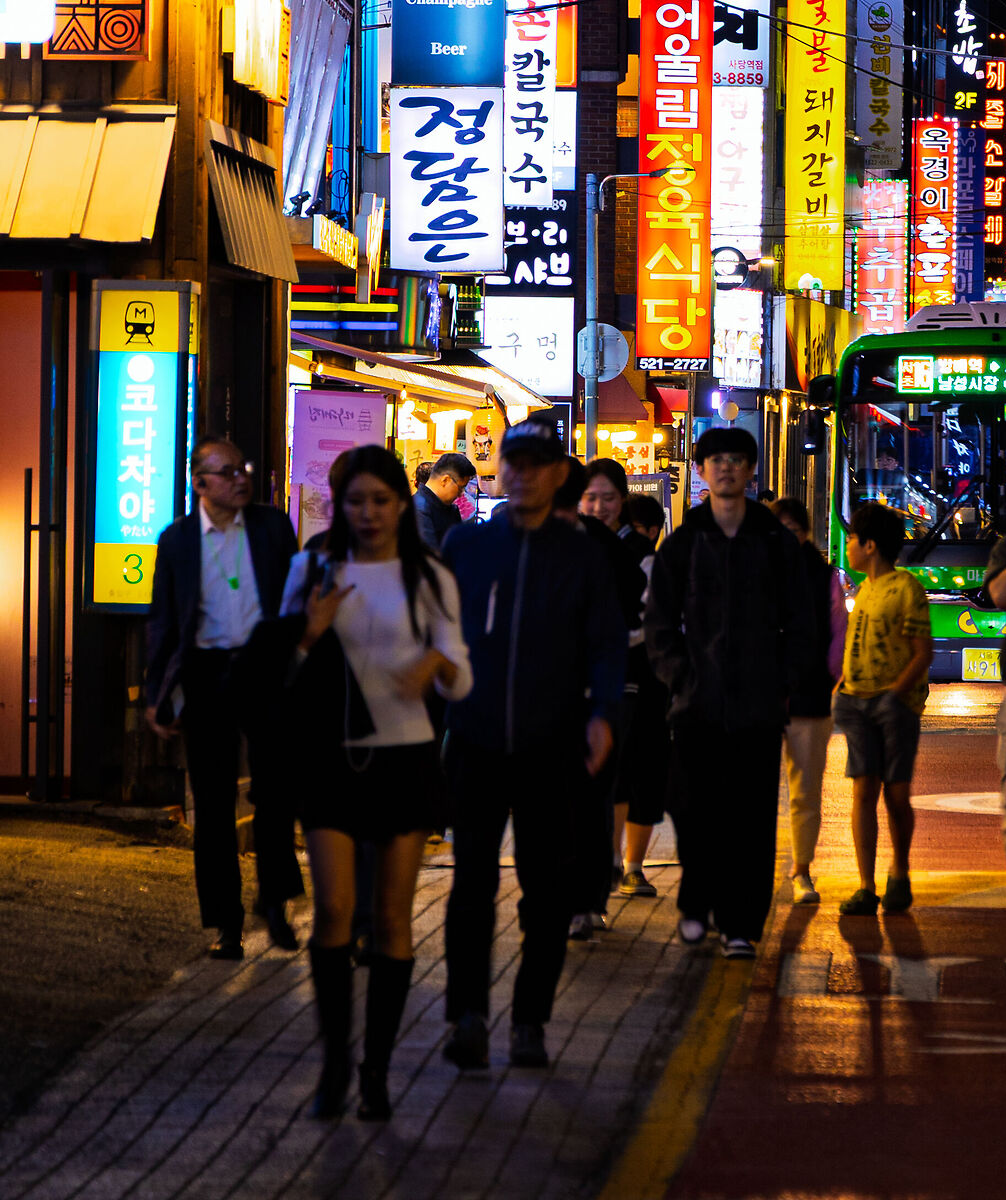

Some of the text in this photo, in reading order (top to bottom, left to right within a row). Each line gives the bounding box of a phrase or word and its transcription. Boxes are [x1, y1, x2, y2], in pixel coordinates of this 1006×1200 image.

[430, 43, 467, 56] Beer
[955, 92, 977, 110] 2F
[802, 87, 835, 218] 돼지갈비
[642, 0, 706, 351] 어울림 정육식당
[920, 128, 952, 211] 옥경이
[498, 332, 557, 361] 구멍
[639, 357, 707, 371] 521-2727
[937, 375, 999, 391] 남성시장
[117, 384, 158, 522] 코다차야
[123, 554, 144, 584] 3
